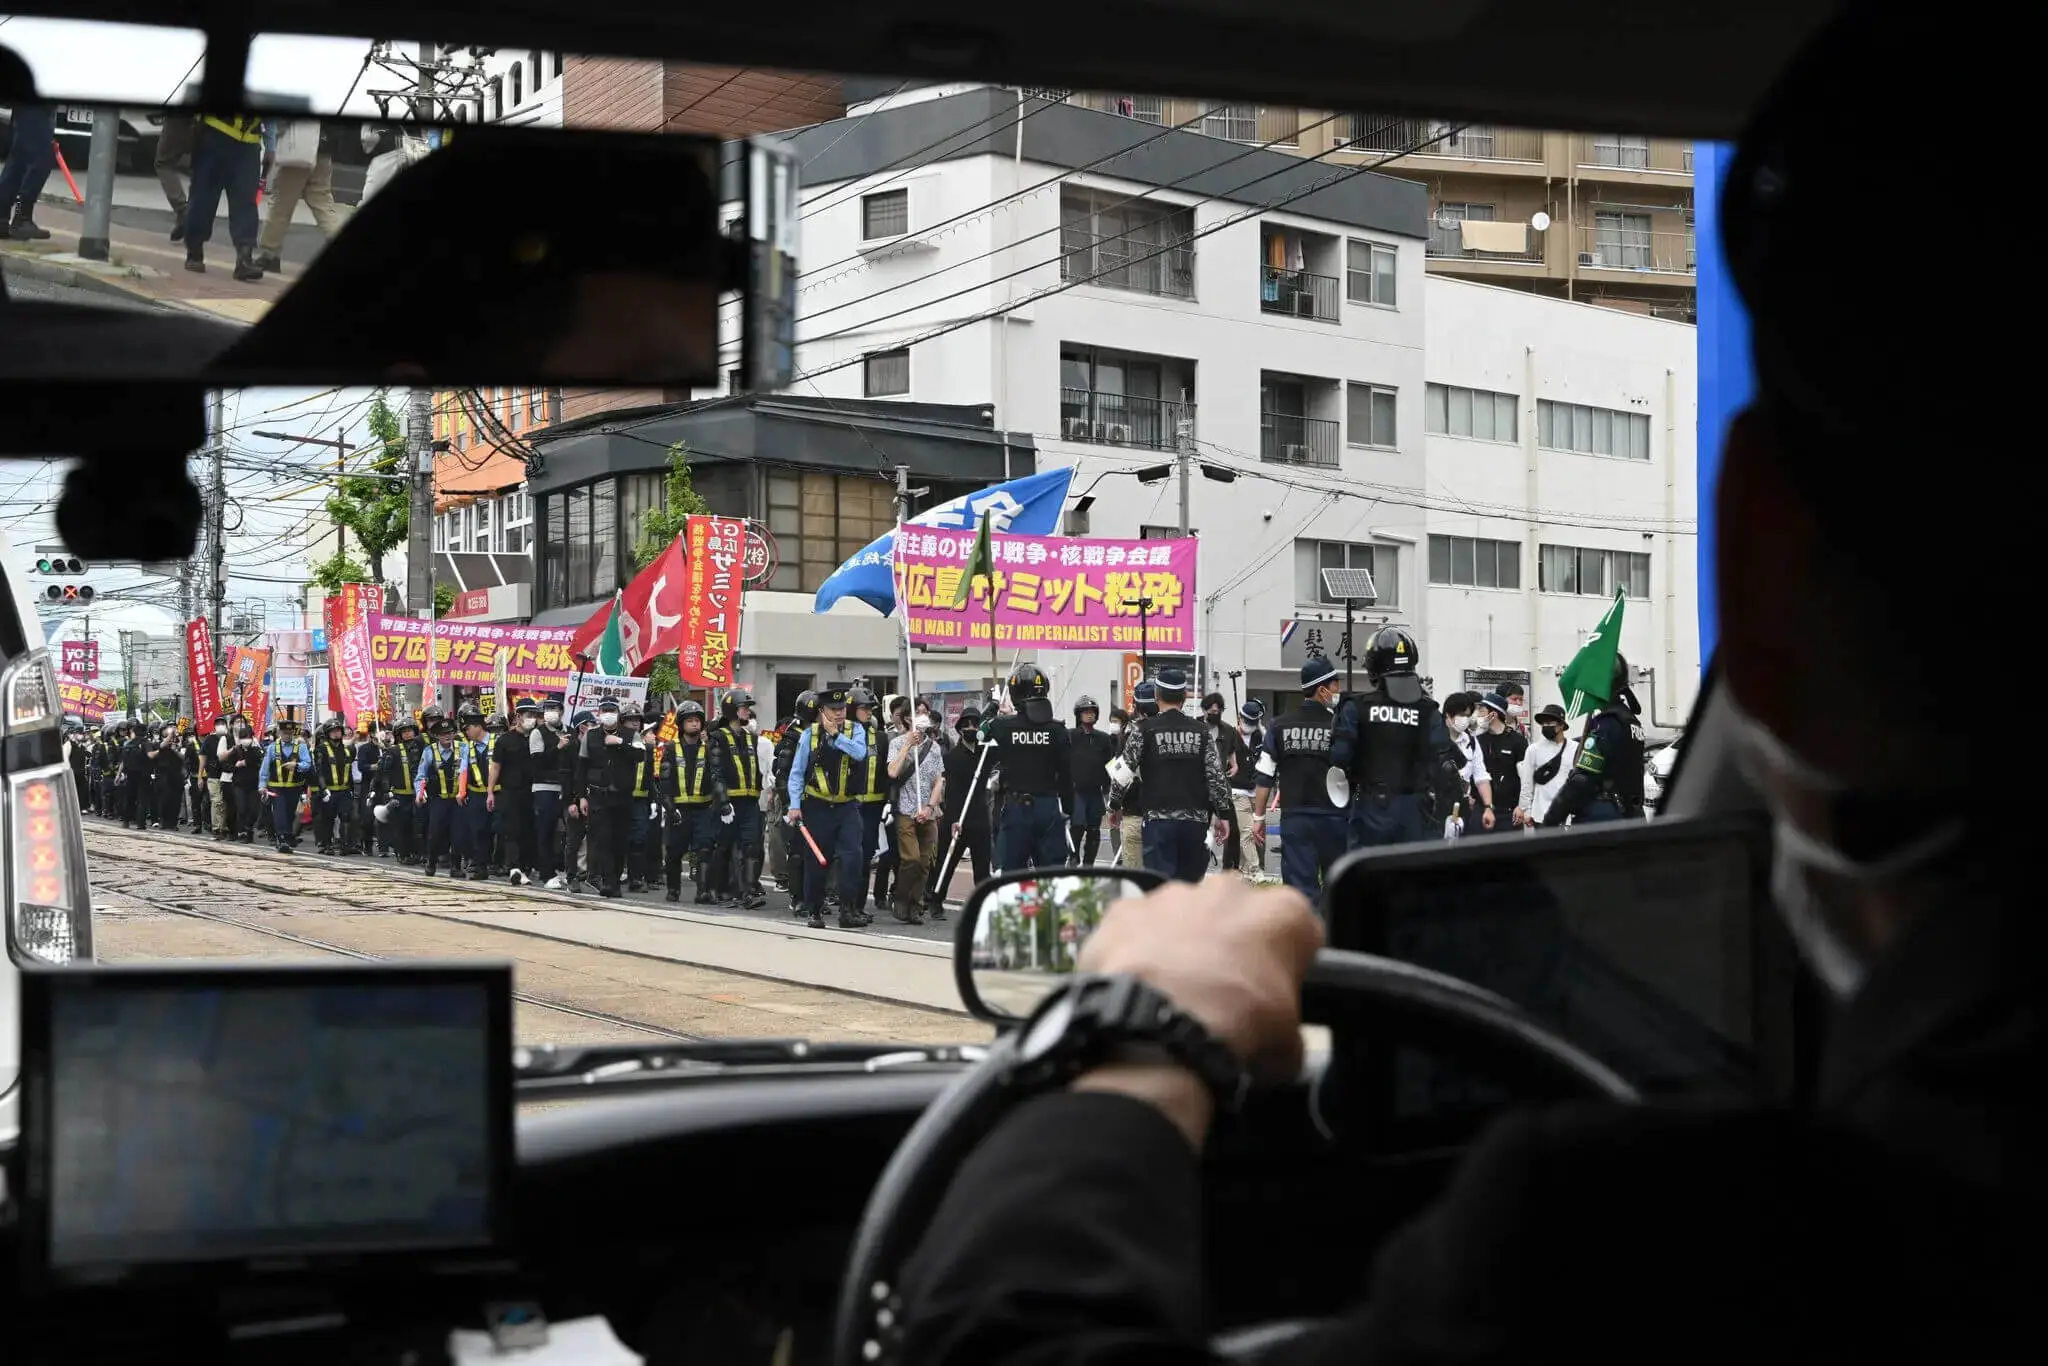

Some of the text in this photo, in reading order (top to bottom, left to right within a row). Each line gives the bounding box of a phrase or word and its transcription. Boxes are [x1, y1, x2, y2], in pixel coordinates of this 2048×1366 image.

[971, 622, 991, 640] NO
[995, 623, 1014, 640] G7
[1017, 625, 1109, 642] IMPERIALIST
[479, 671, 537, 685] IMPIALIST
[1370, 706, 1419, 726] POLICE
[1011, 732, 1050, 745] POLICE
[1155, 732, 1201, 745] POLICE
[1283, 727, 1331, 742] POLICE
